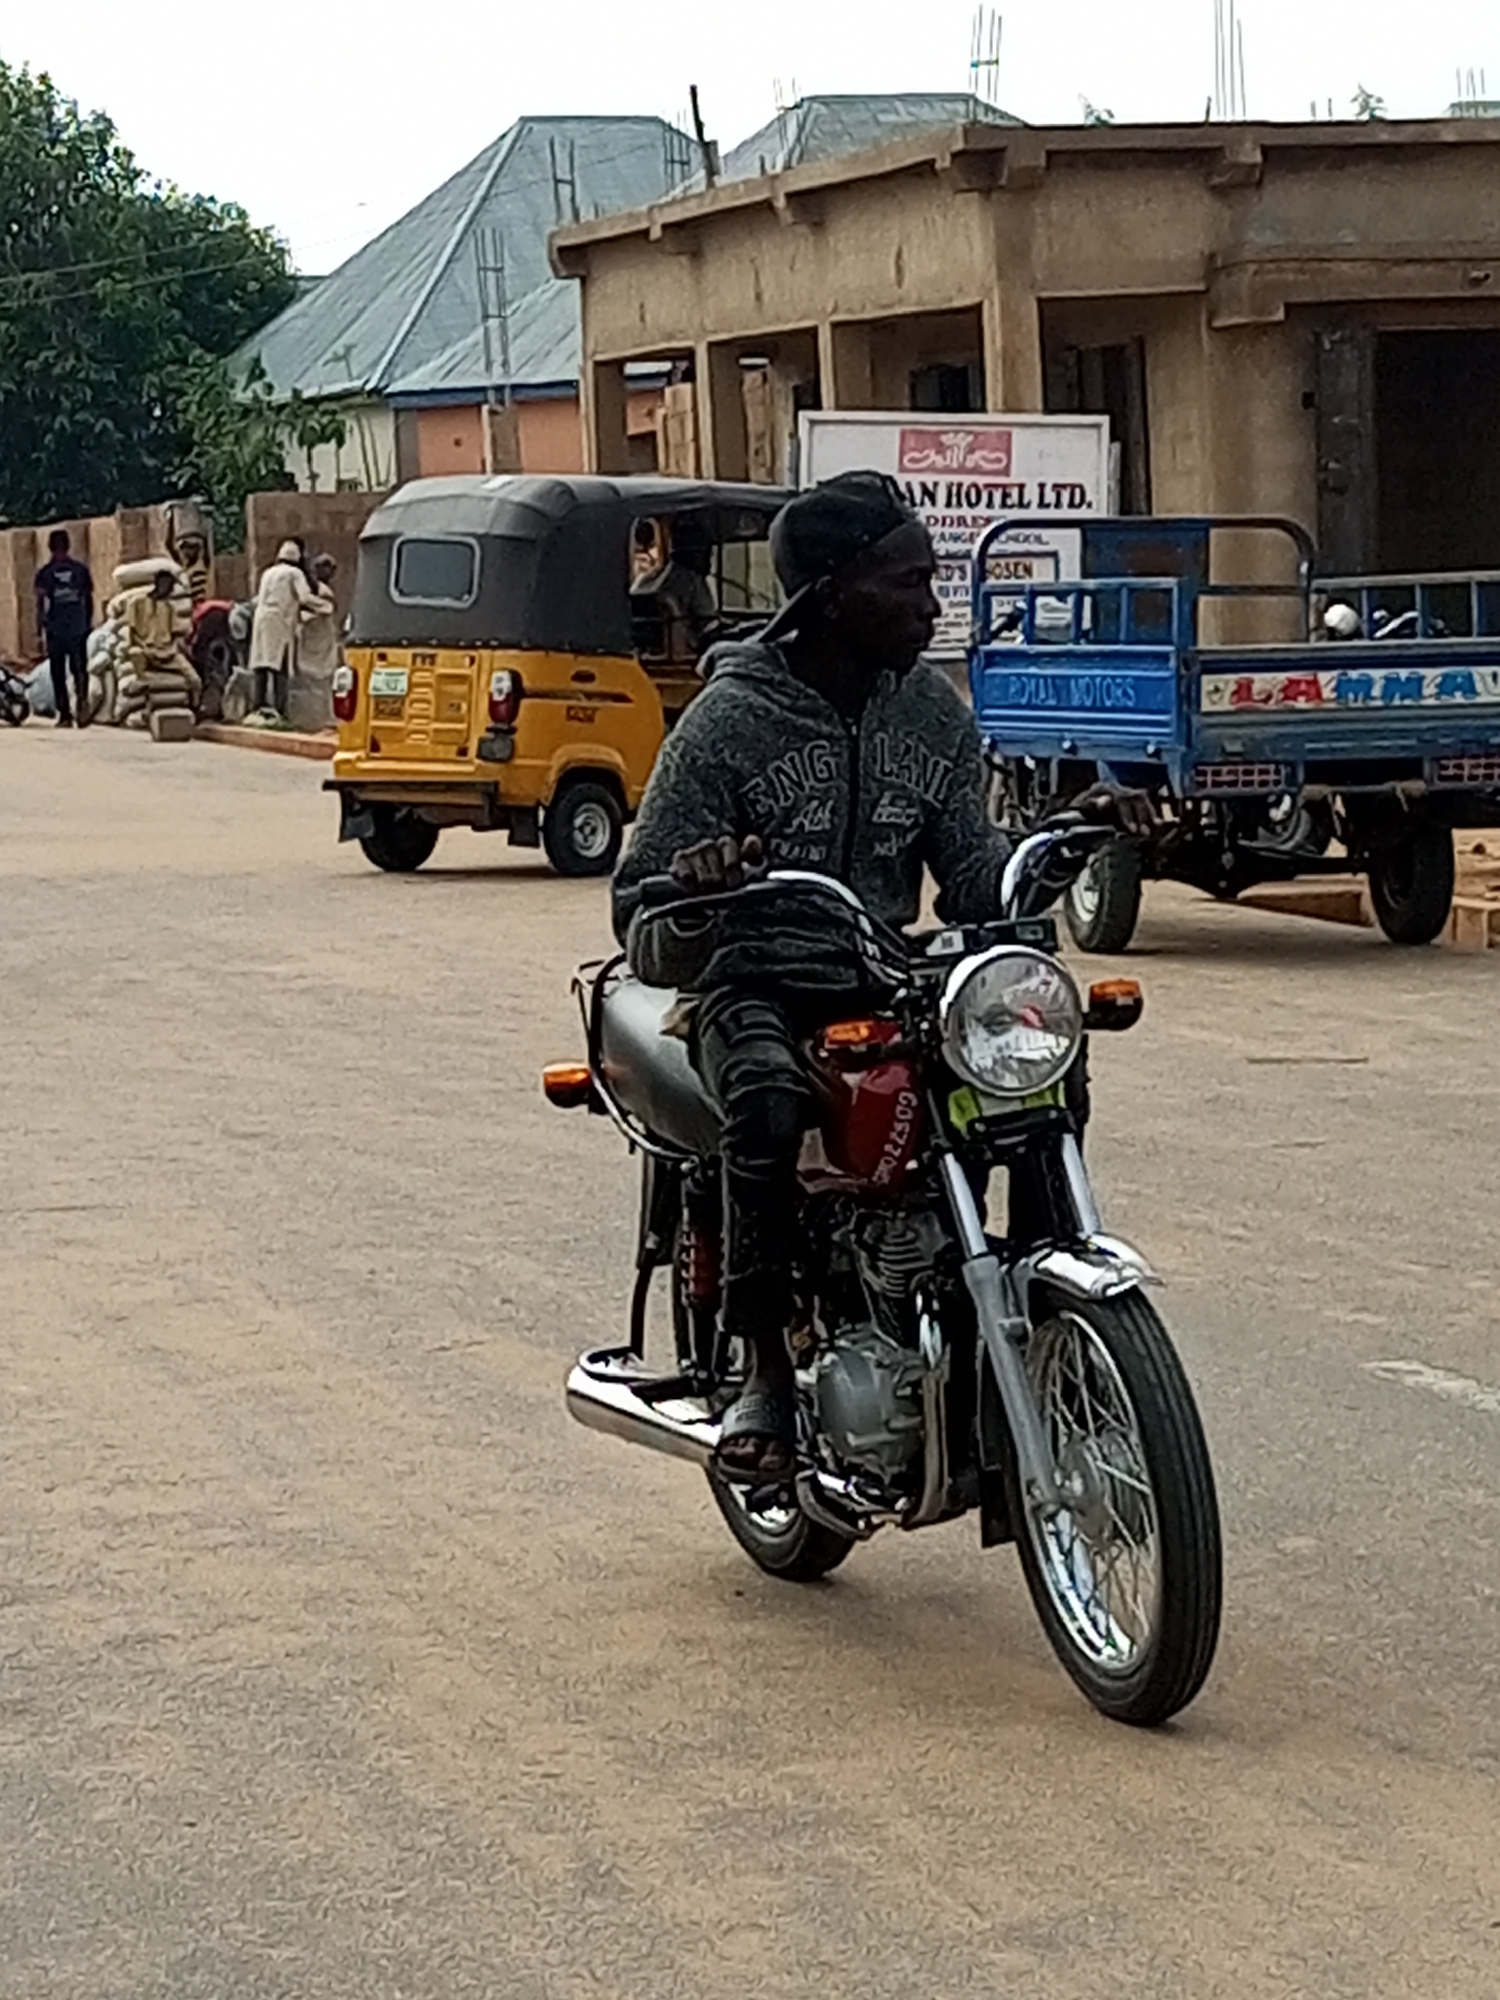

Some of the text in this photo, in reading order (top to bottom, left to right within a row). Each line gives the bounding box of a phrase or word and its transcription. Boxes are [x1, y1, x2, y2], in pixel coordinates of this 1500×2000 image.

[905, 481, 1093, 509] AN HOTEL LTD.
[987, 561, 1033, 581] OSEN
